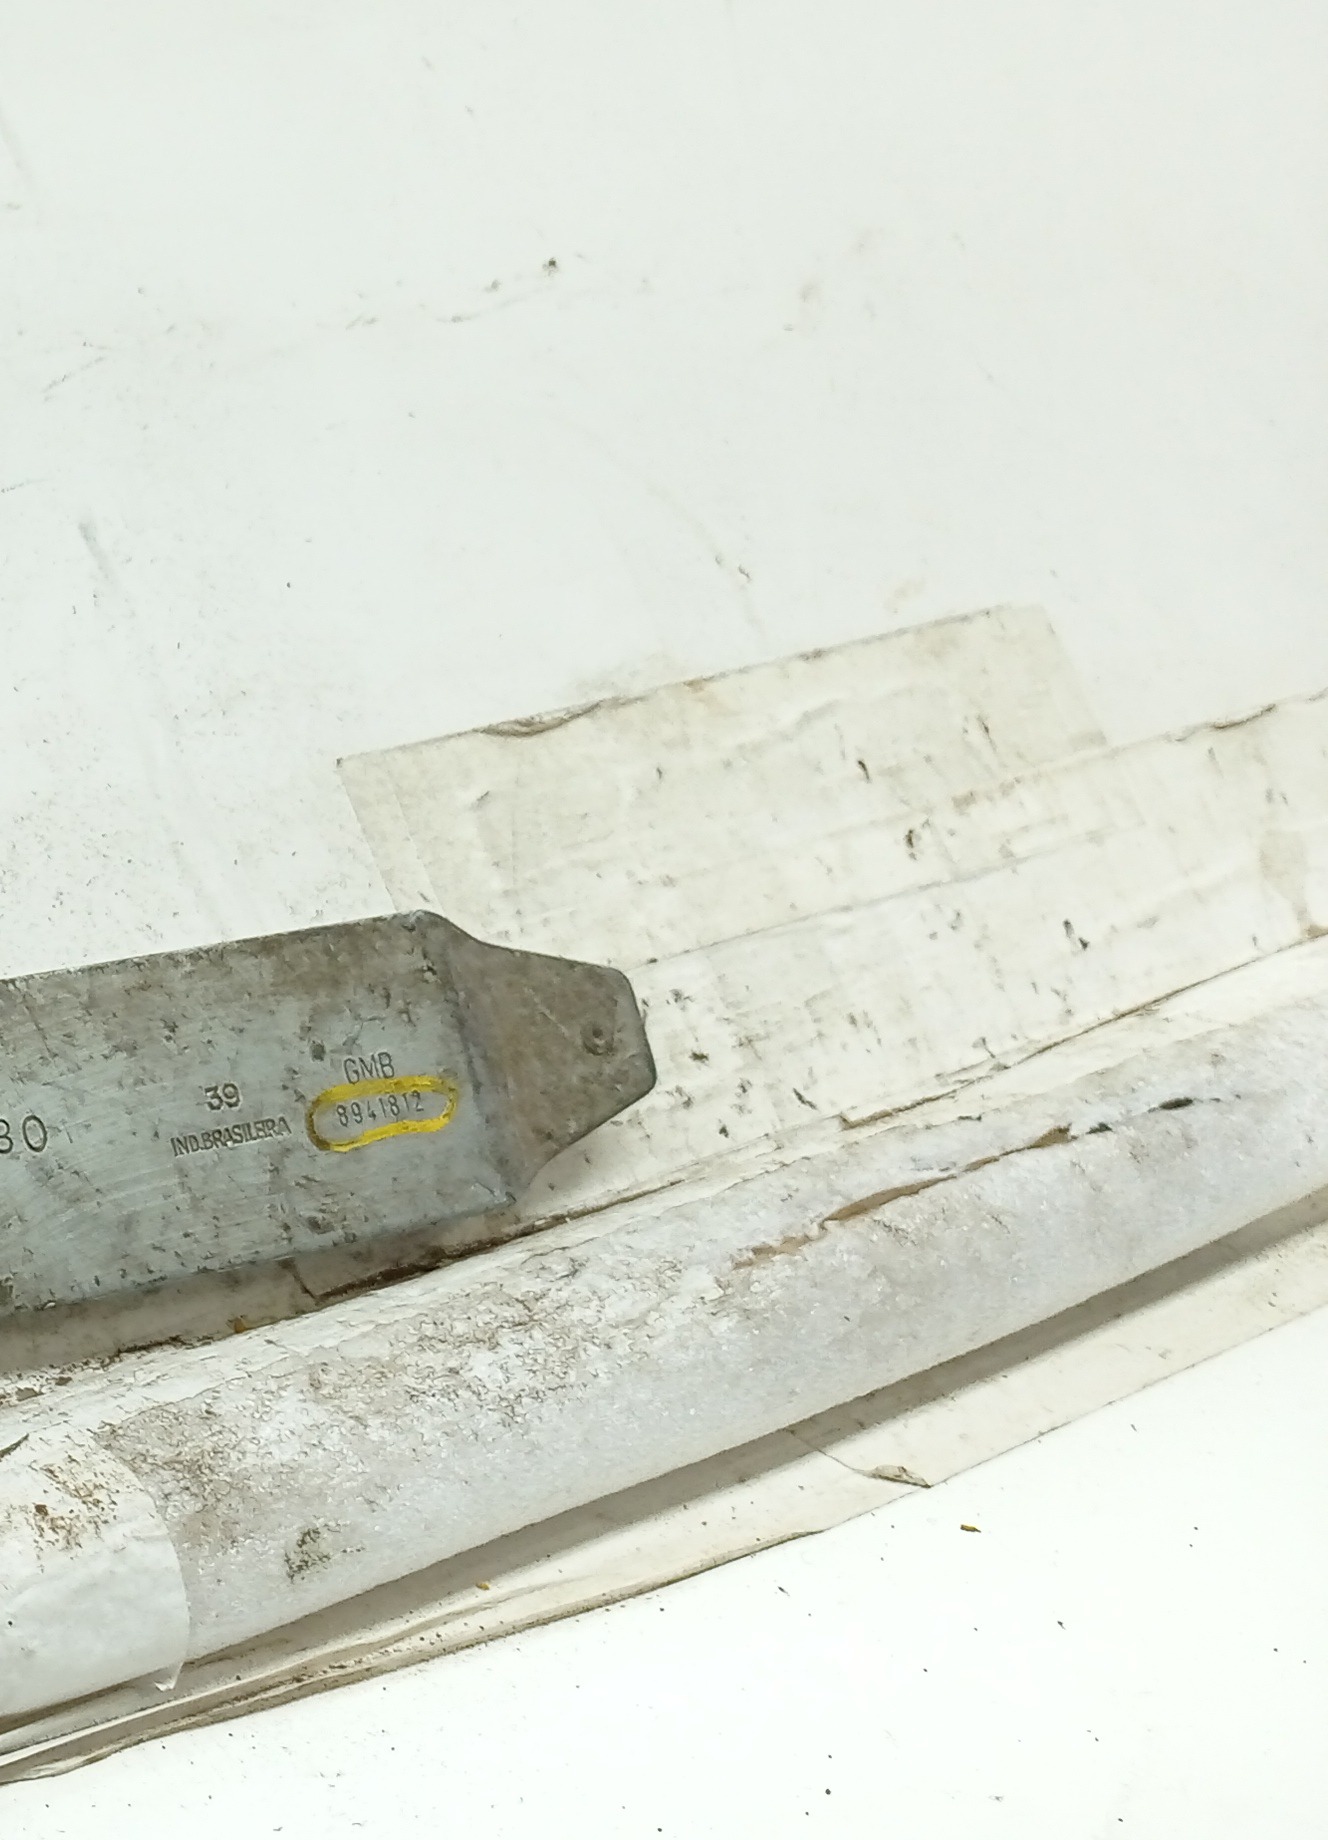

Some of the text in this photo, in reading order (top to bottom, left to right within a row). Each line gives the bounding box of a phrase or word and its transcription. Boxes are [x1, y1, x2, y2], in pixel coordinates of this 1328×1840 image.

[344, 1051, 396, 1085] GMB
[204, 1083, 242, 1111] 39
[336, 1089, 425, 1128] 8941812
